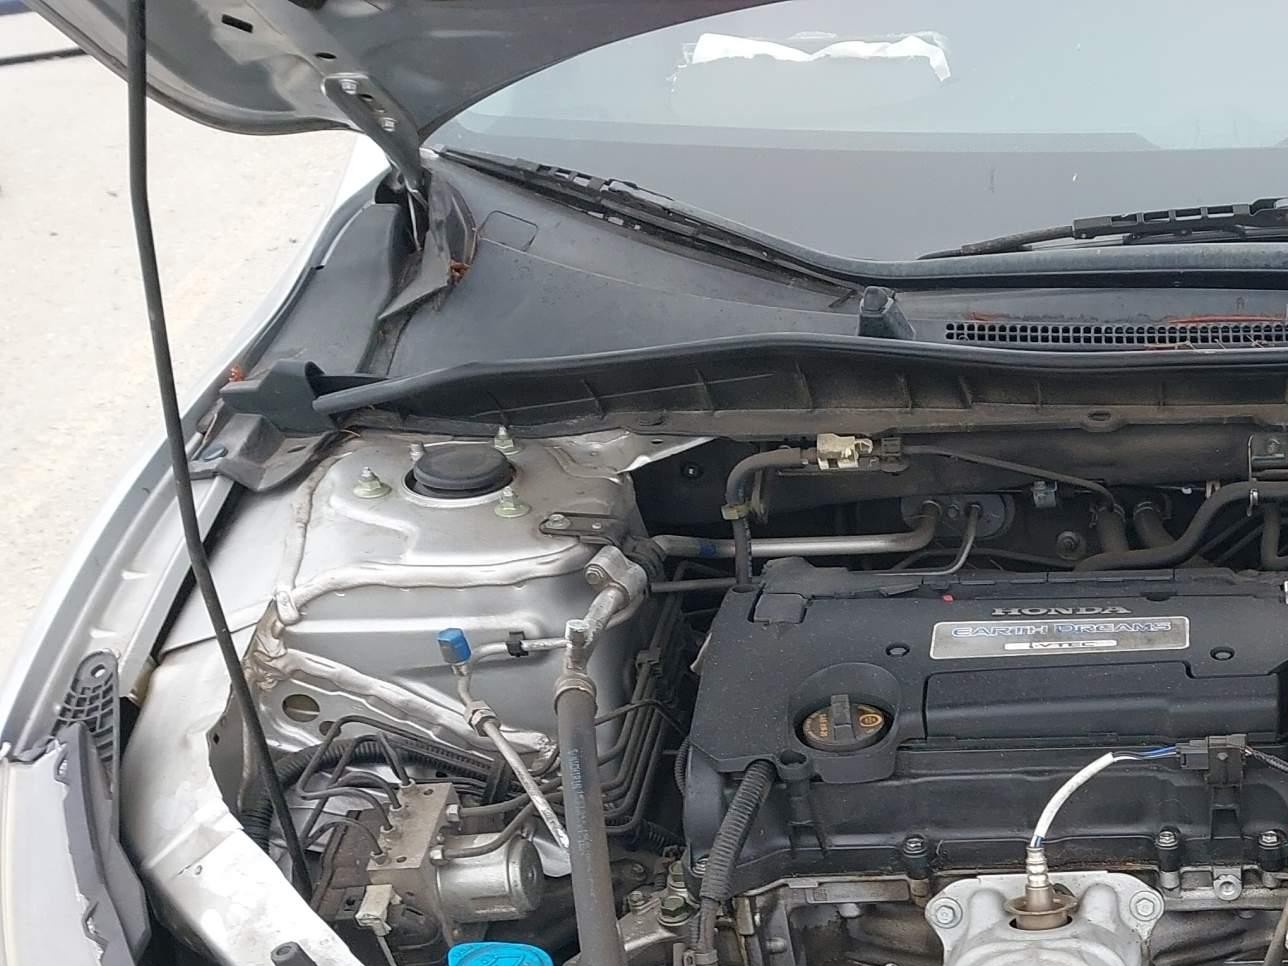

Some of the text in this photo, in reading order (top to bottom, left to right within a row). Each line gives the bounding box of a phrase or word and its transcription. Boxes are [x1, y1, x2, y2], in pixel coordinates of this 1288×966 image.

[991, 606, 1132, 617] HONDA
[951, 621, 1172, 638] EARTH DREAMS
